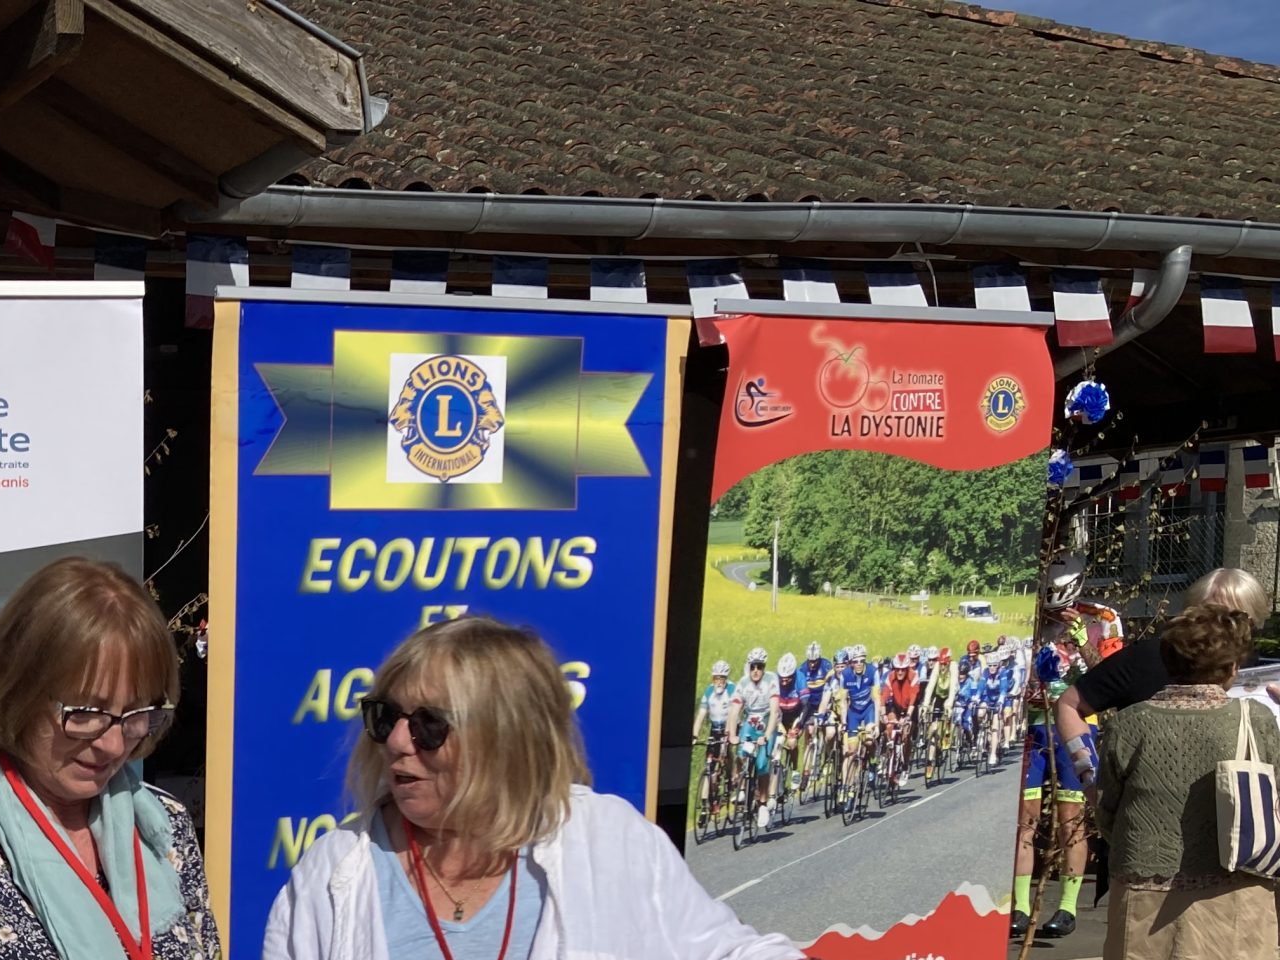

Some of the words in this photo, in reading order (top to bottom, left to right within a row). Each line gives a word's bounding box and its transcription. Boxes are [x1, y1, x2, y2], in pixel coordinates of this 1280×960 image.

[417, 360, 480, 387] LIONS
[892, 370, 903, 384] La
[907, 372, 944, 385] tomate
[991, 378, 1017, 391] LIONS
[892, 391, 942, 412] CONTRE
[435, 395, 462, 437] L
[831, 414, 852, 437] LA
[860, 415, 945, 438] DYSTONIE
[414, 449, 478, 472] INTERNATIONAL
[298, 536, 598, 593] ECOUTONS
